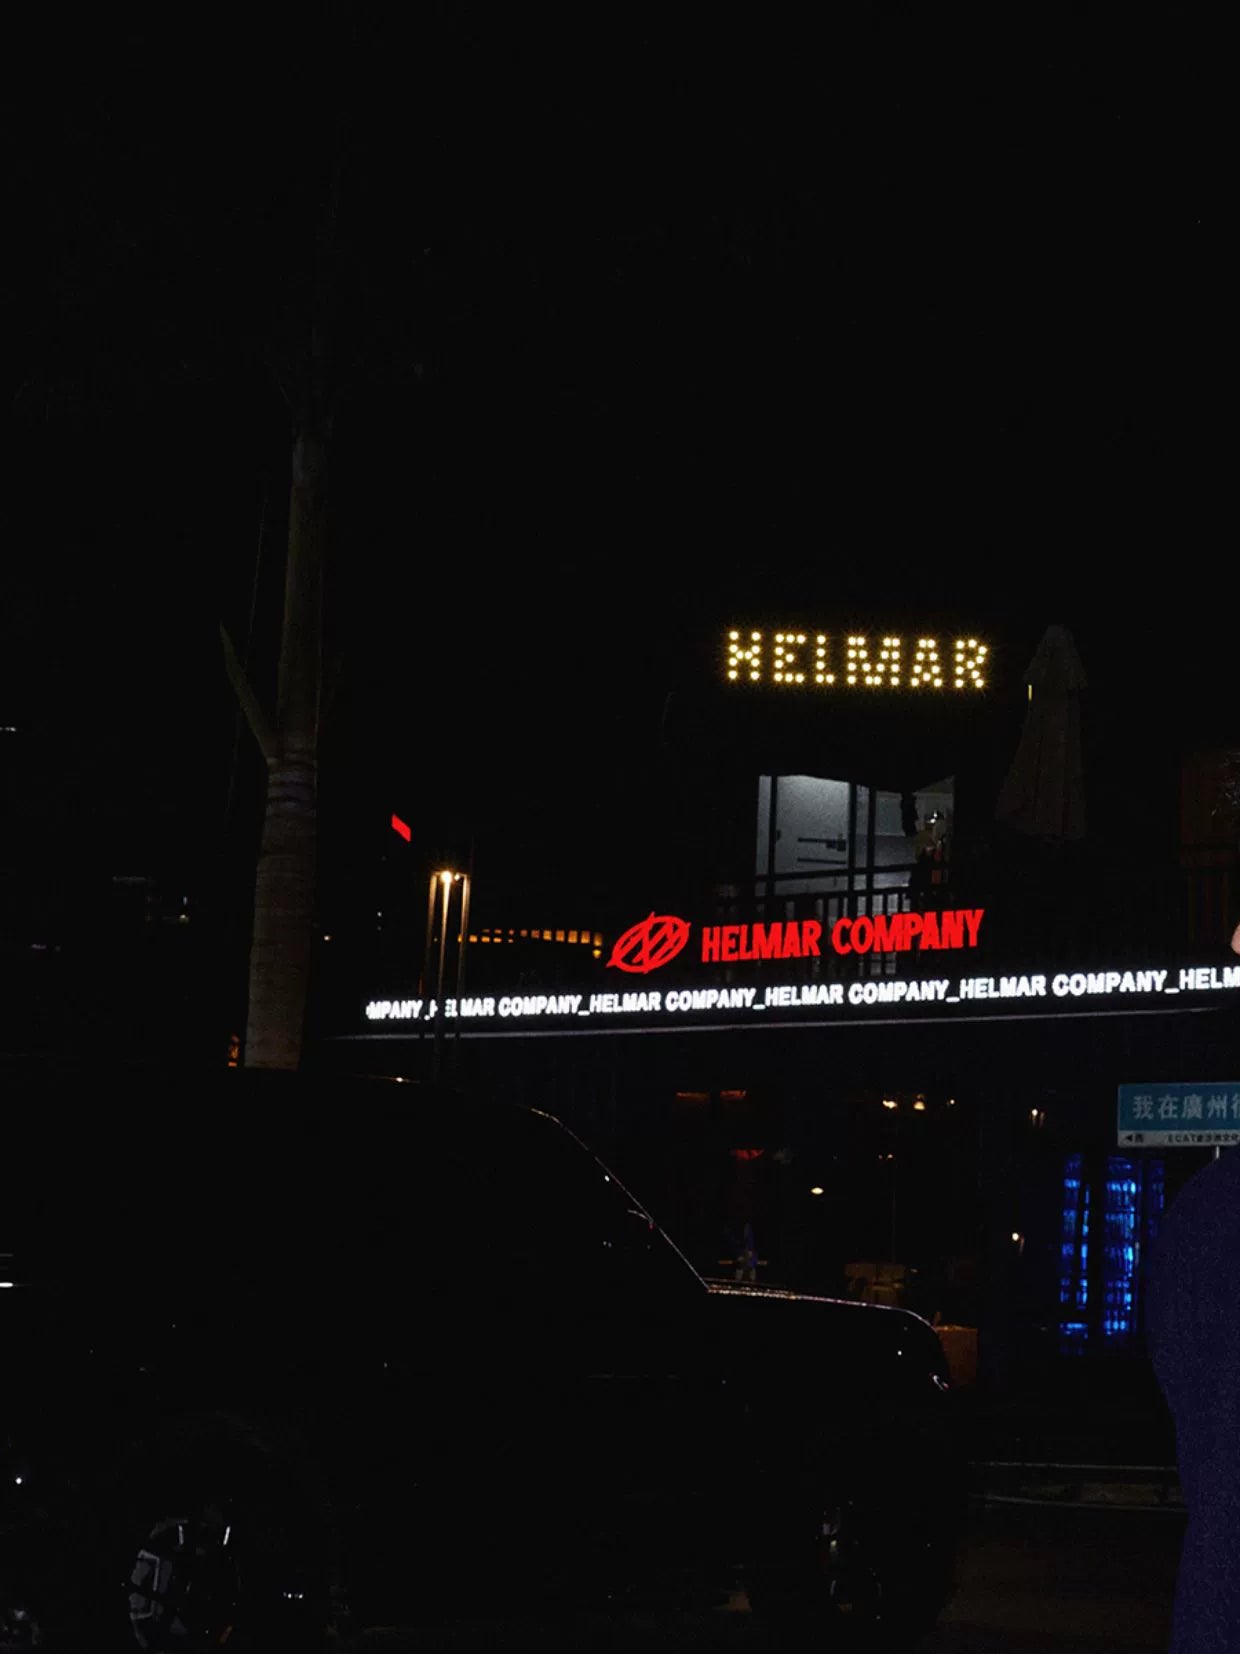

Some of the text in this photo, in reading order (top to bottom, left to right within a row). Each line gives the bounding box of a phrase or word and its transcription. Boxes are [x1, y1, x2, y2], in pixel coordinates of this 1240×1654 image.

[727, 629, 988, 689] HELMAR
[701, 909, 984, 963] HELMAR COMPANY
